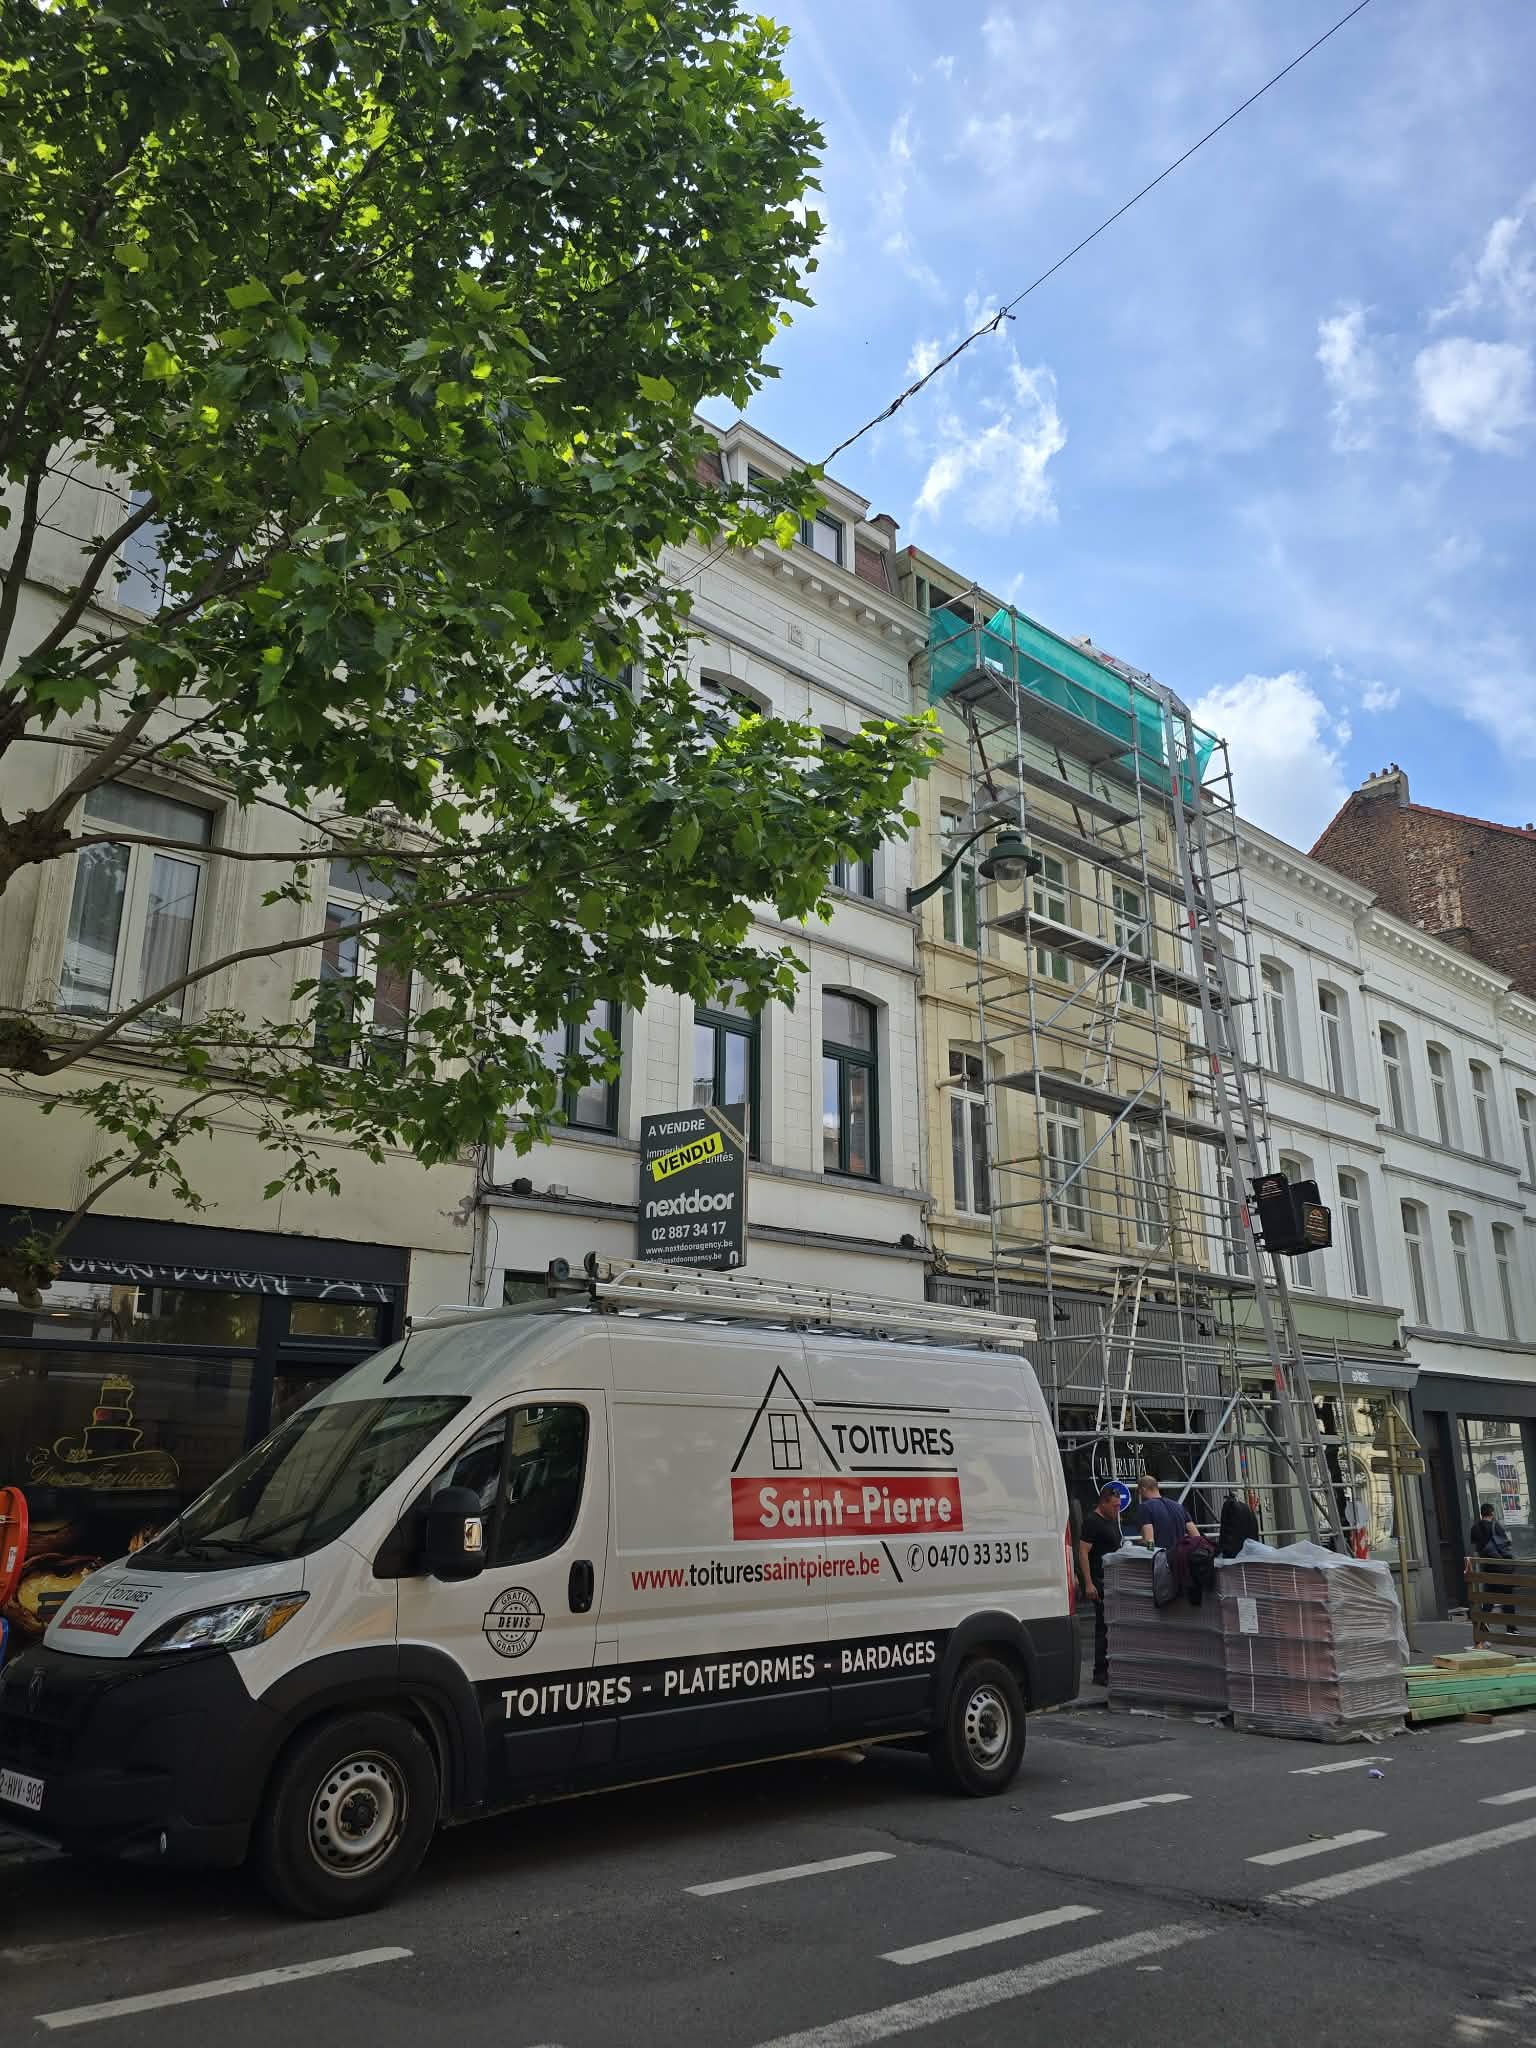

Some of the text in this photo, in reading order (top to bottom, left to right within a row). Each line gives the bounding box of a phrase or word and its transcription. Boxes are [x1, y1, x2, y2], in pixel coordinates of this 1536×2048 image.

[648, 1119, 705, 1137] A VENDRE
[658, 1138, 716, 1176] VENDU
[646, 1187, 734, 1219] nextdoor
[652, 1221, 727, 1241] 02 887 34 17
[646, 1239, 733, 1255] www.nextdooragency.be
[832, 1424, 954, 1456] TOITURES
[758, 1486, 952, 1528] Saint-Pierre
[631, 1541, 1029, 1591] www.toituressaintpierre.be 0470 33 33 15
[111, 1588, 153, 1603] TOITURES
[502, 1590, 535, 1606] GRATUIT
[66, 1608, 124, 1632] Saint-Pierre
[498, 1615, 532, 1629] DEVIS
[496, 1638, 529, 1654] GRATUIT
[501, 1675, 632, 1719] TOITURES
[664, 1653, 816, 1697] PLATEFORMES
[840, 1640, 935, 1674] BARDAGES
